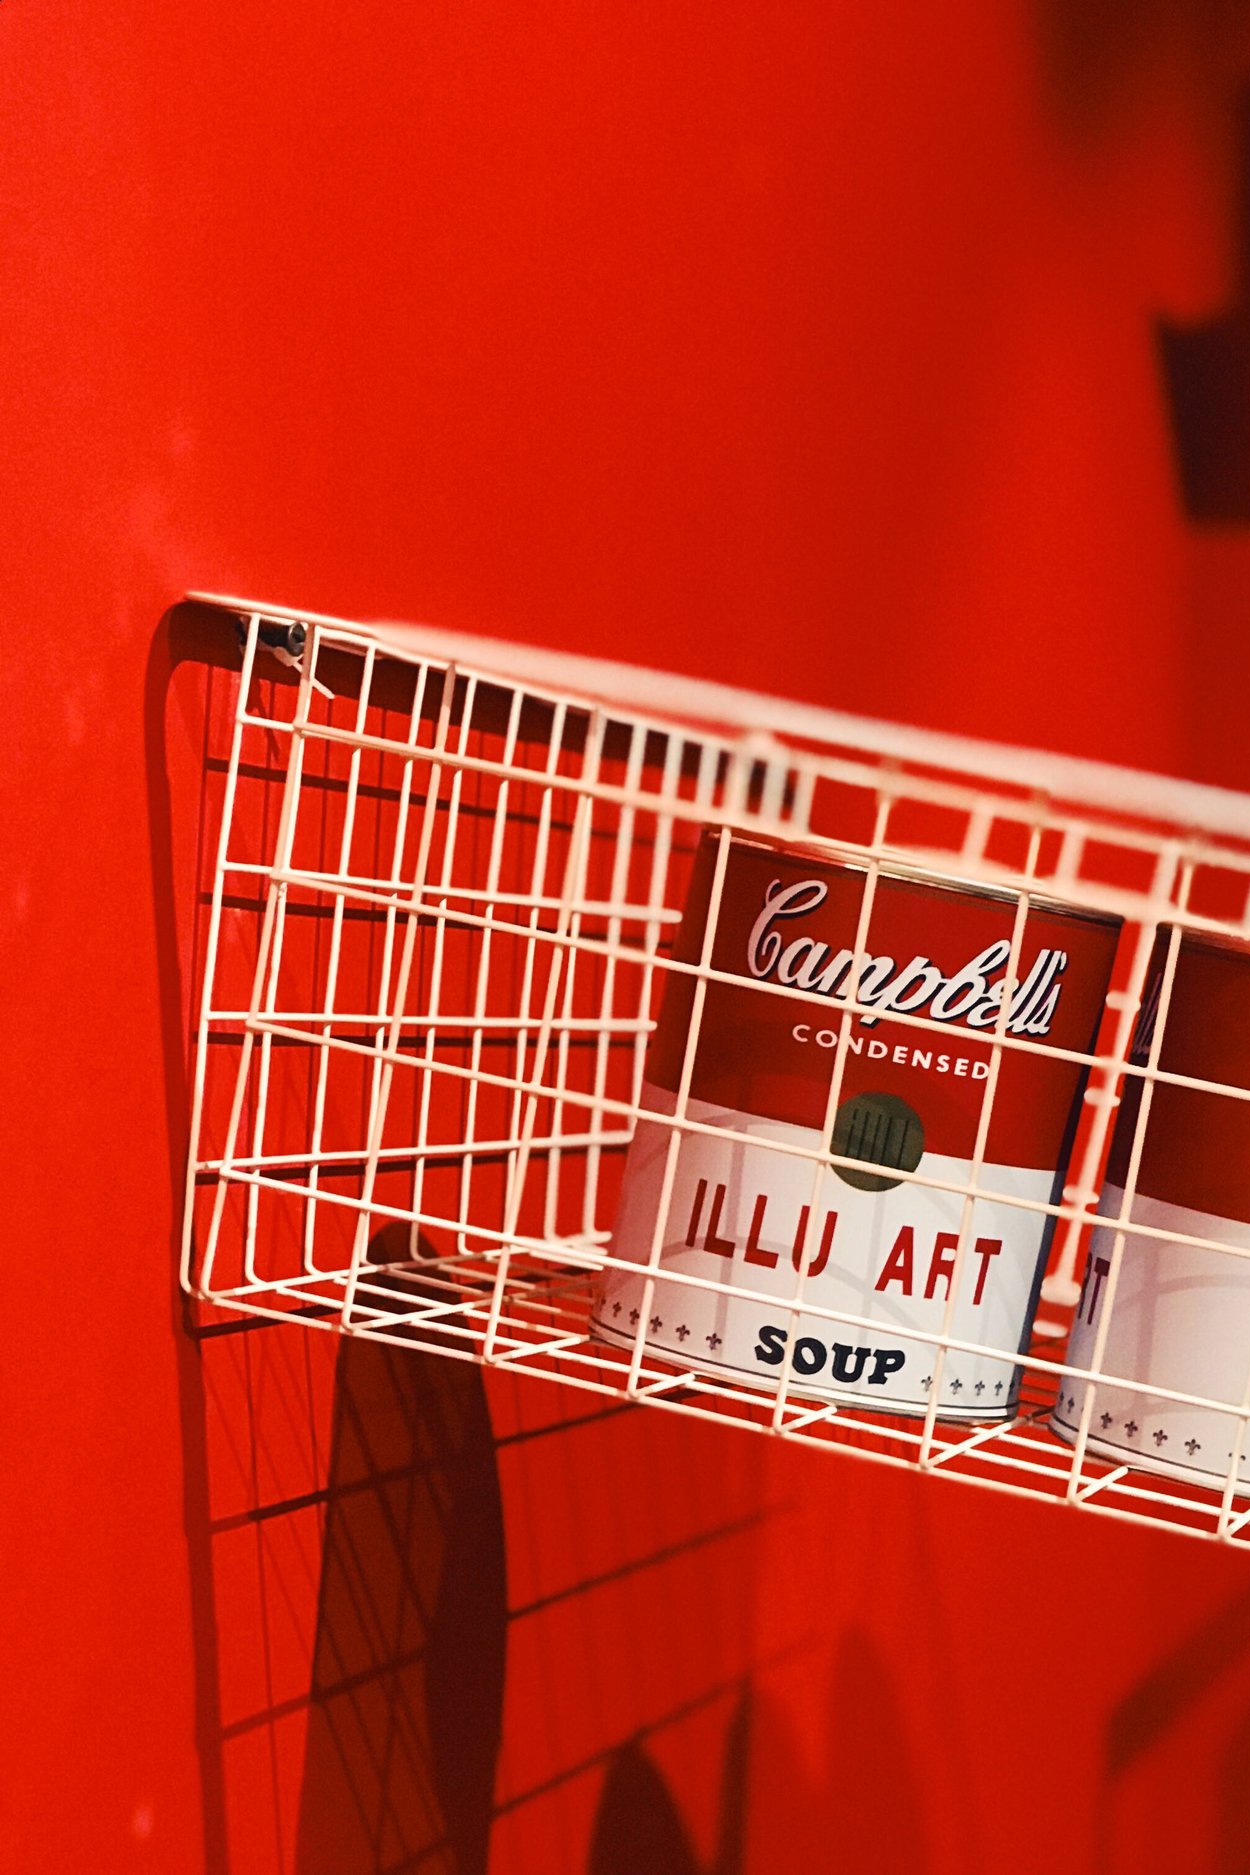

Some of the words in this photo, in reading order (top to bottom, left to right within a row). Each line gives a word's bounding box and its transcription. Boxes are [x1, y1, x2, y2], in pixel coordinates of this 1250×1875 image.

[747, 878, 1068, 1036] Campbell's
[792, 1023, 991, 1080] CONDENSED
[684, 1178, 838, 1277] ILLU
[874, 1225, 1003, 1305] ART
[754, 1325, 906, 1385] SOUP
